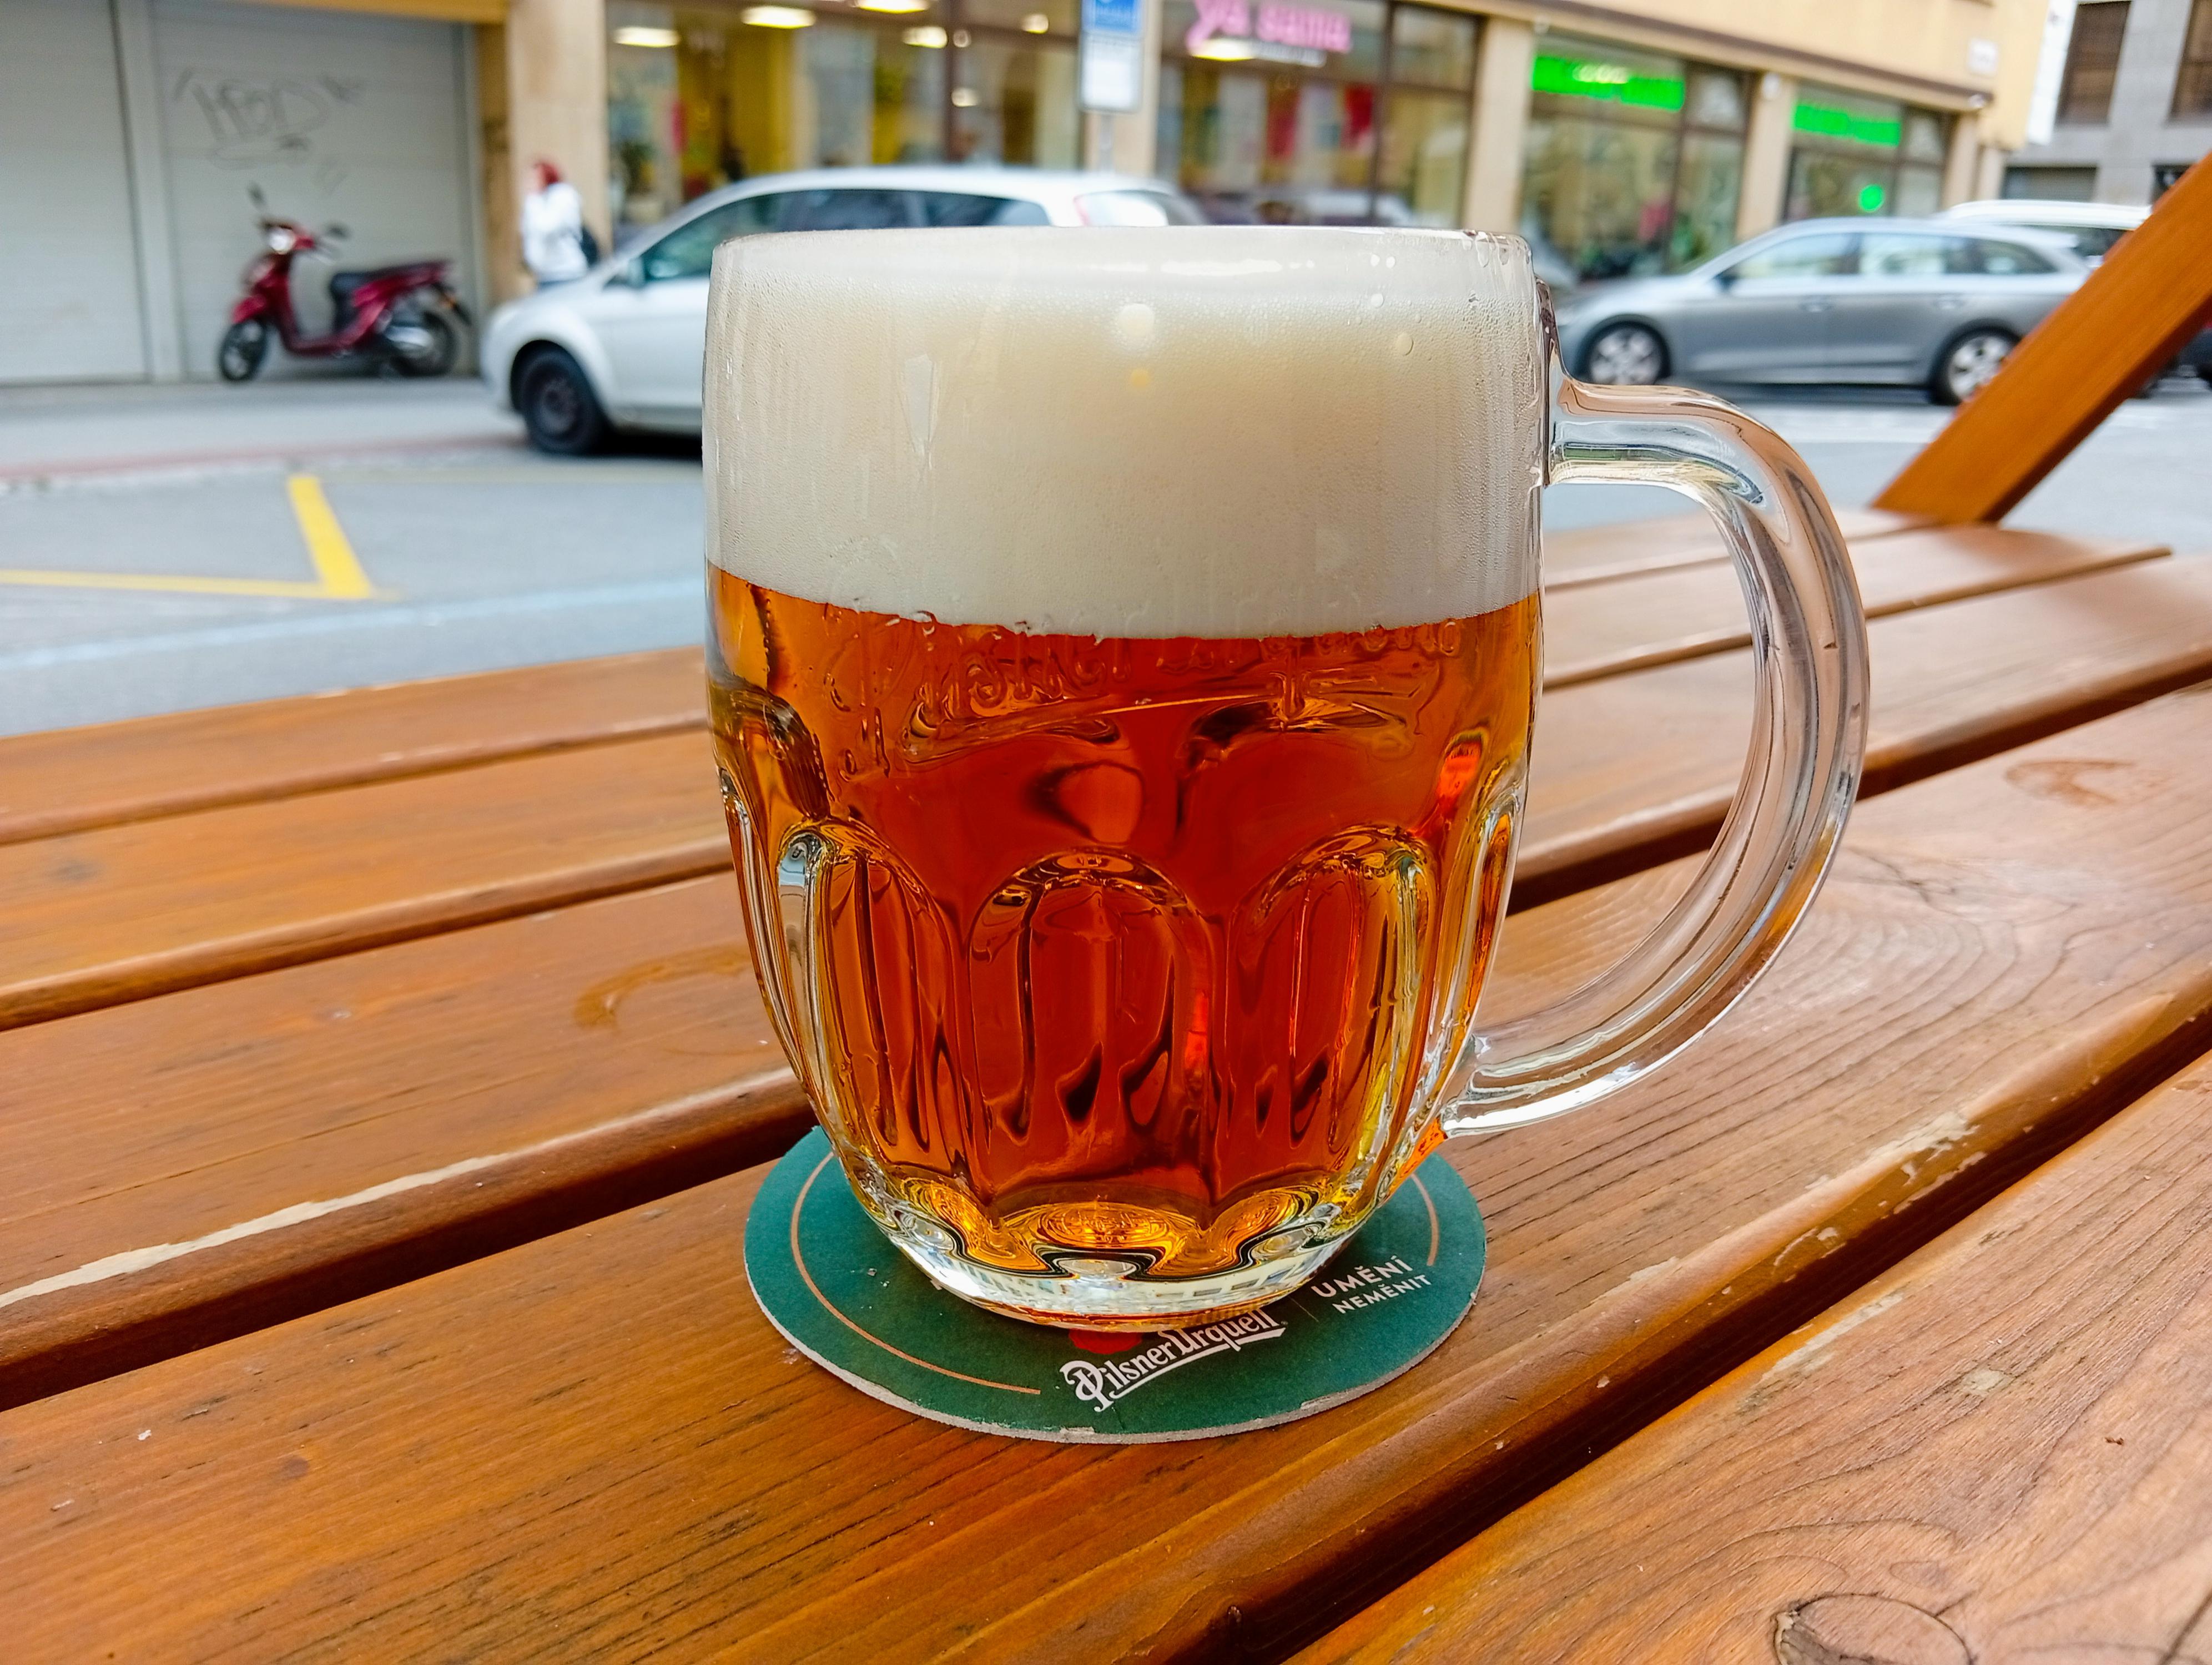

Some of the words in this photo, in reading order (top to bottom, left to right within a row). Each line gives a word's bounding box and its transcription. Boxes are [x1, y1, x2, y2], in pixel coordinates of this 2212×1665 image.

[1311, 1255, 1413, 1298] UMĚNÍ
[1332, 1274, 1432, 1314] NEMĚNIT
[1059, 1341, 1178, 1412] Pilsner
[1158, 1309, 1280, 1352] Urquell
